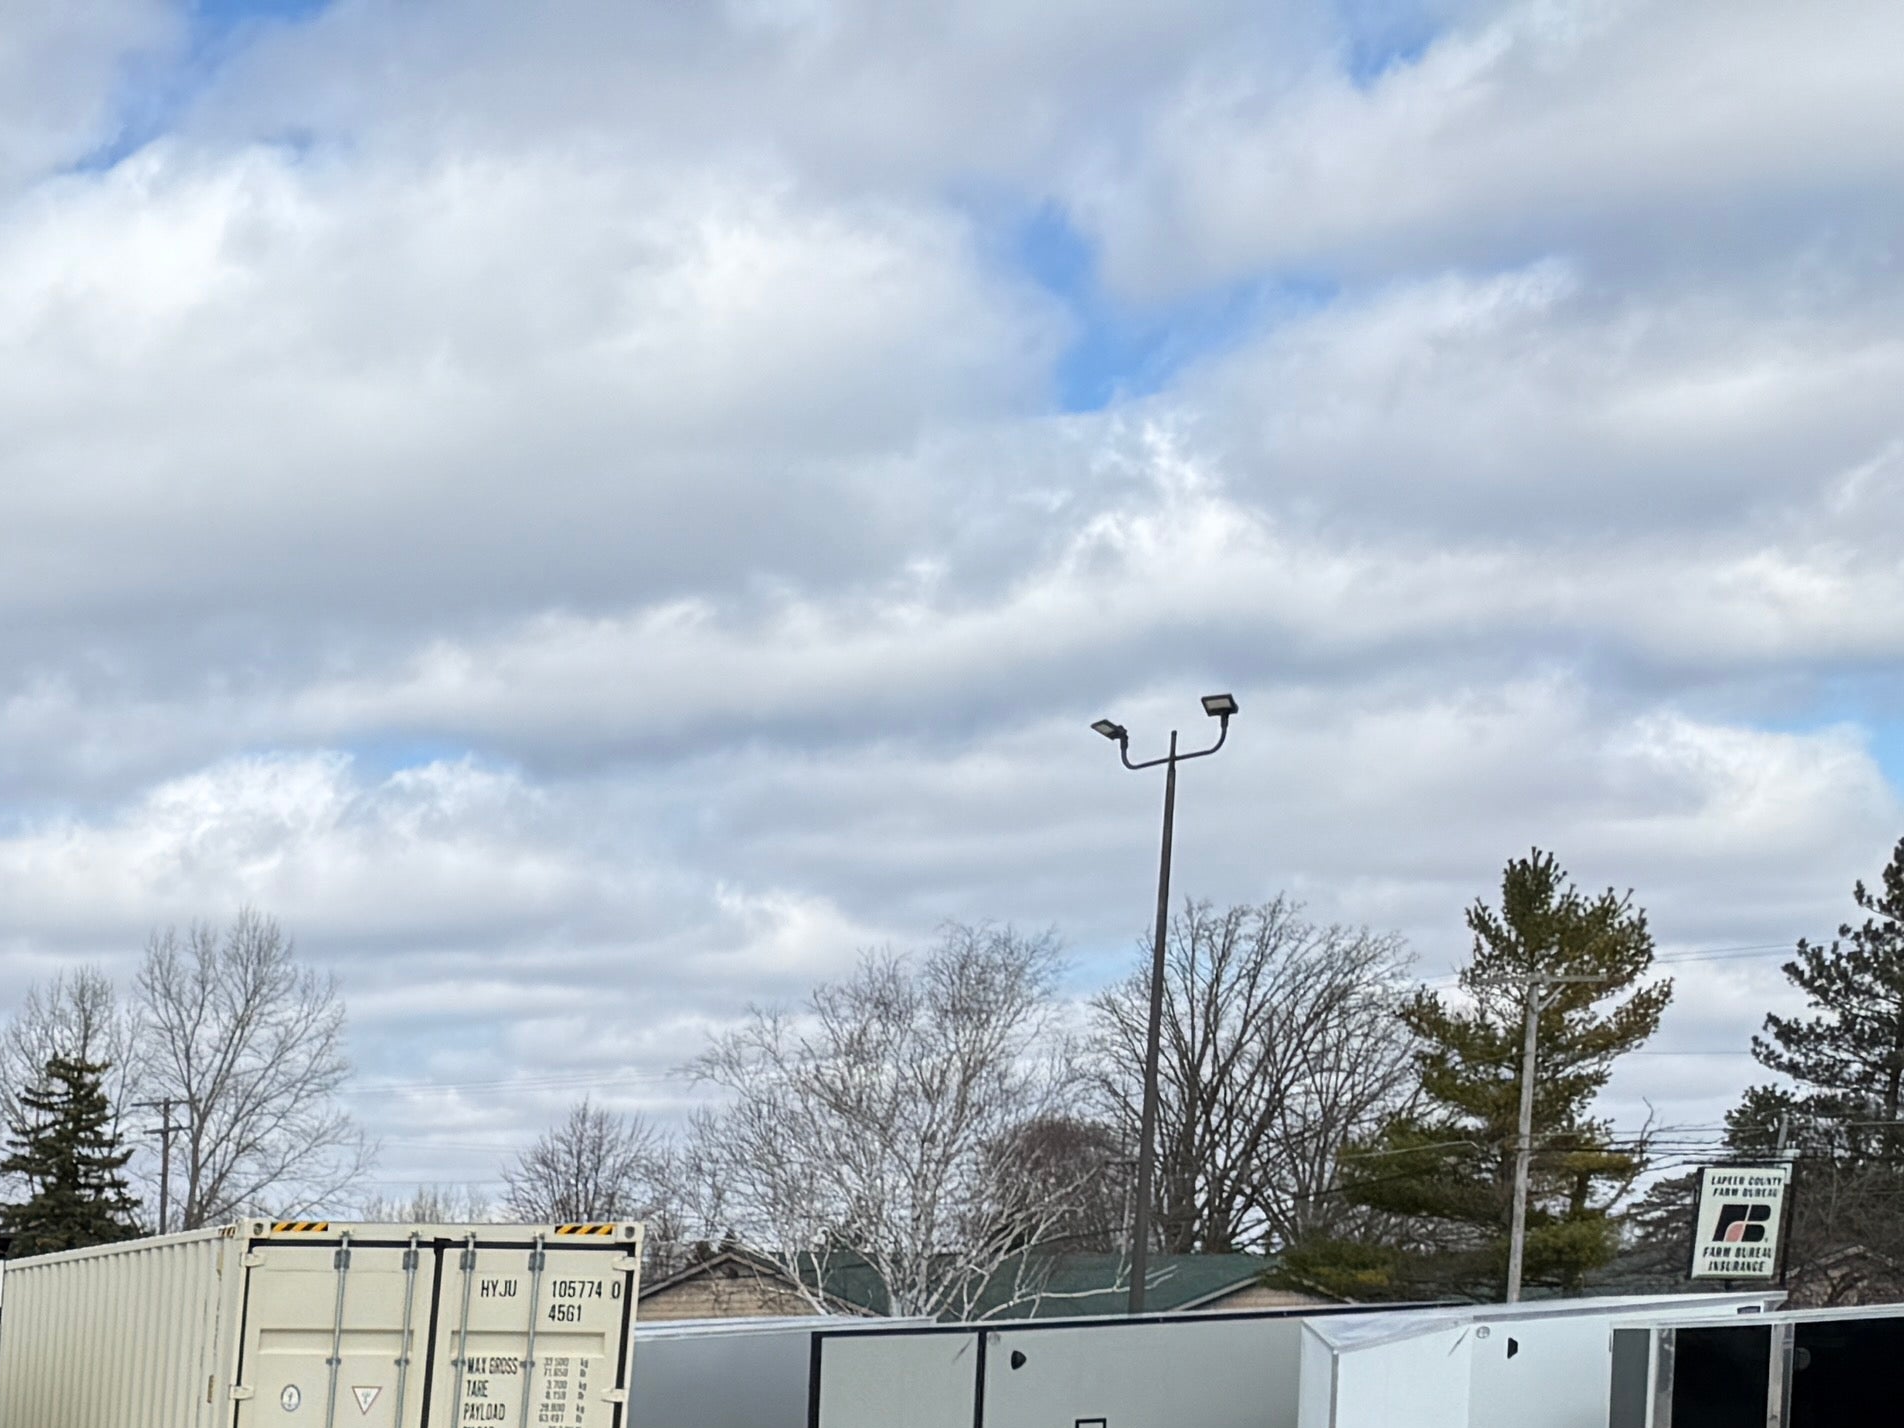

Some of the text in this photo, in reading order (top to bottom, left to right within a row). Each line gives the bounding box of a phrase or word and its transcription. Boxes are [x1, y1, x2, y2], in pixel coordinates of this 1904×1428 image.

[1747, 1177, 1782, 1187] COUNTY
[1712, 1187, 1778, 1198] FARM BUREAU
[1702, 1247, 1772, 1259] FARM BUREAU
[1708, 1261, 1766, 1273] INSURANCE
[481, 1280, 621, 1299] HYJU 105774 0
[467, 1357, 486, 1375] MAX
[489, 1357, 518, 1375] GROSS
[466, 1380, 489, 1398] TARE
[464, 1403, 506, 1421] PAYLOAD
